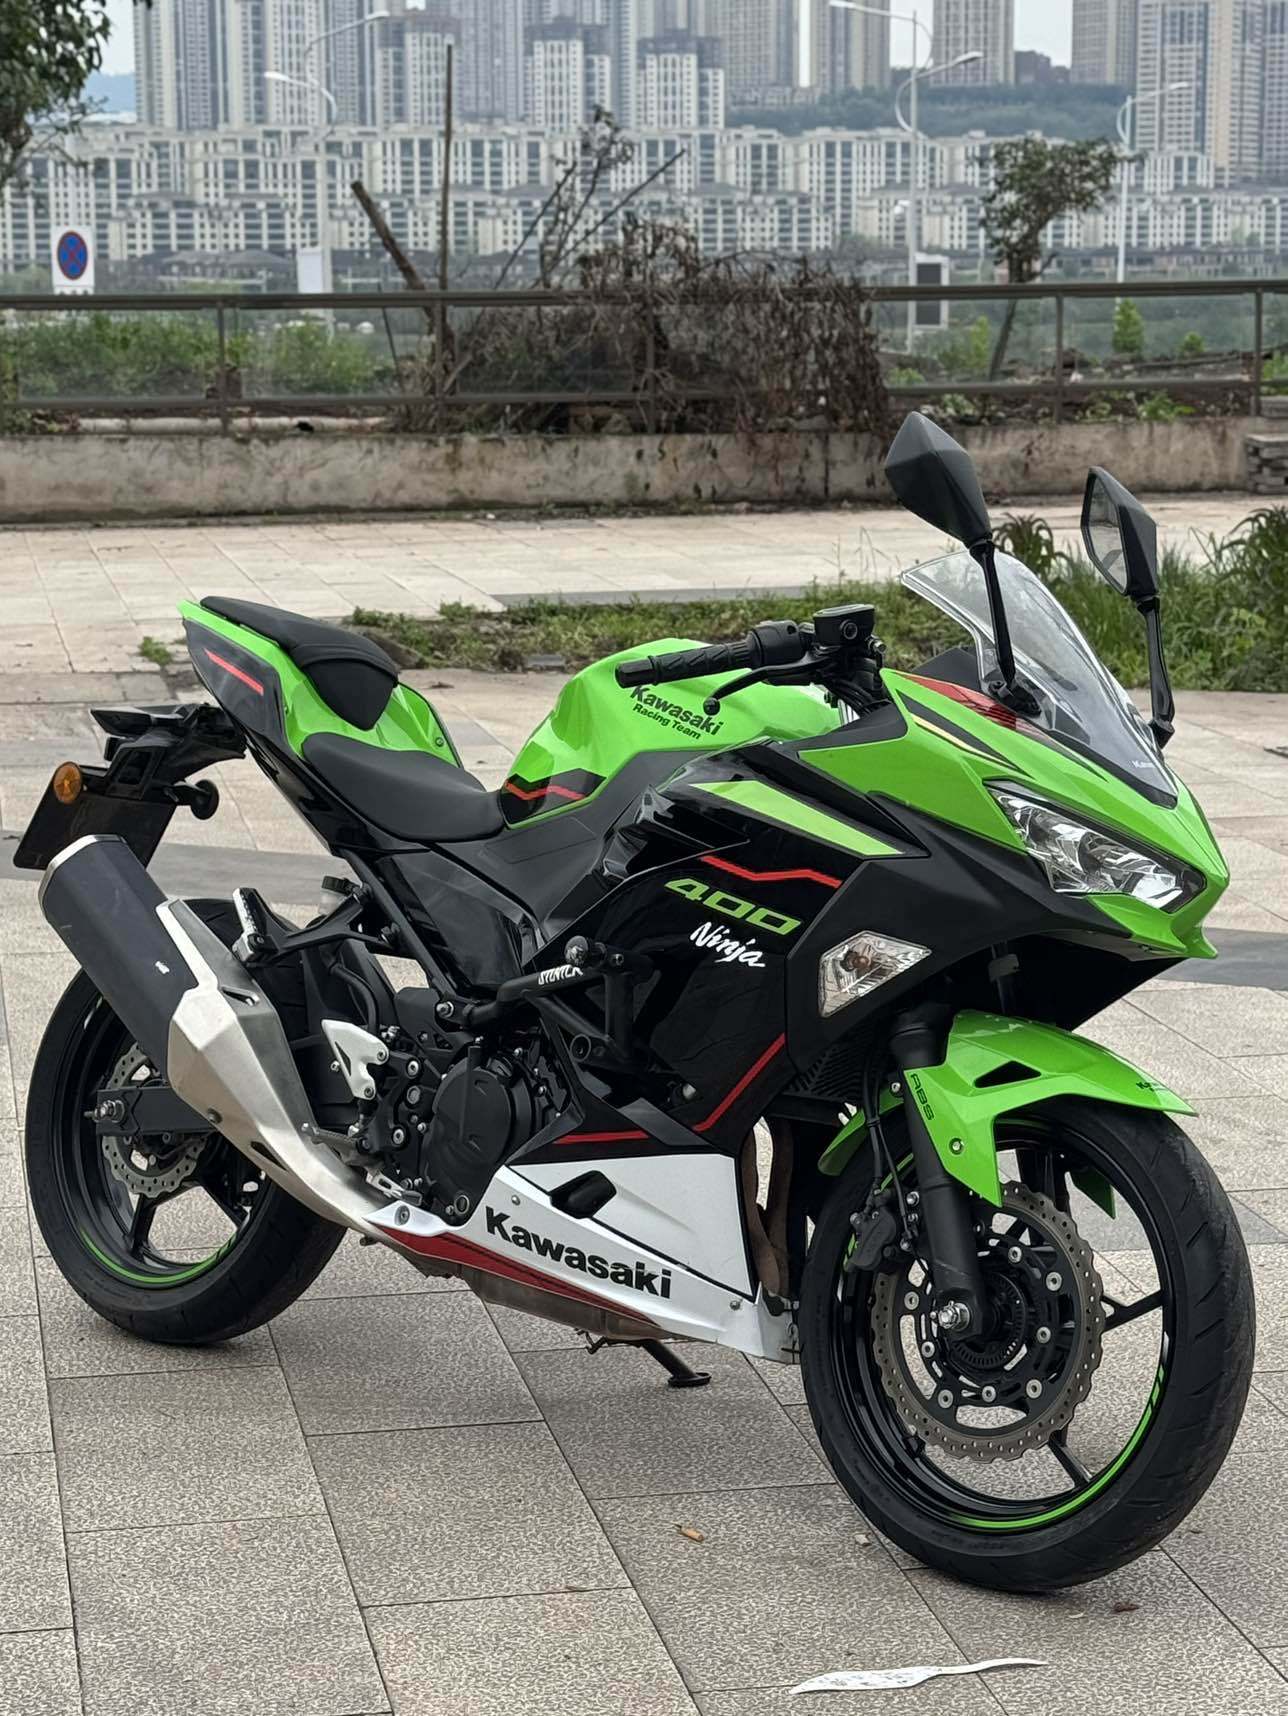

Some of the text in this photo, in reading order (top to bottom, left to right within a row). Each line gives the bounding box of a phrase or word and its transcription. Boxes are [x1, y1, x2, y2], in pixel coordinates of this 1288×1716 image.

[630, 685, 724, 735] Kawasaki
[633, 703, 702, 740] Racing Team
[664, 878, 802, 936] 400
[690, 921, 766, 968] Ninja
[910, 1073, 935, 1121] ABS
[485, 1206, 672, 1299] Kawasaki
